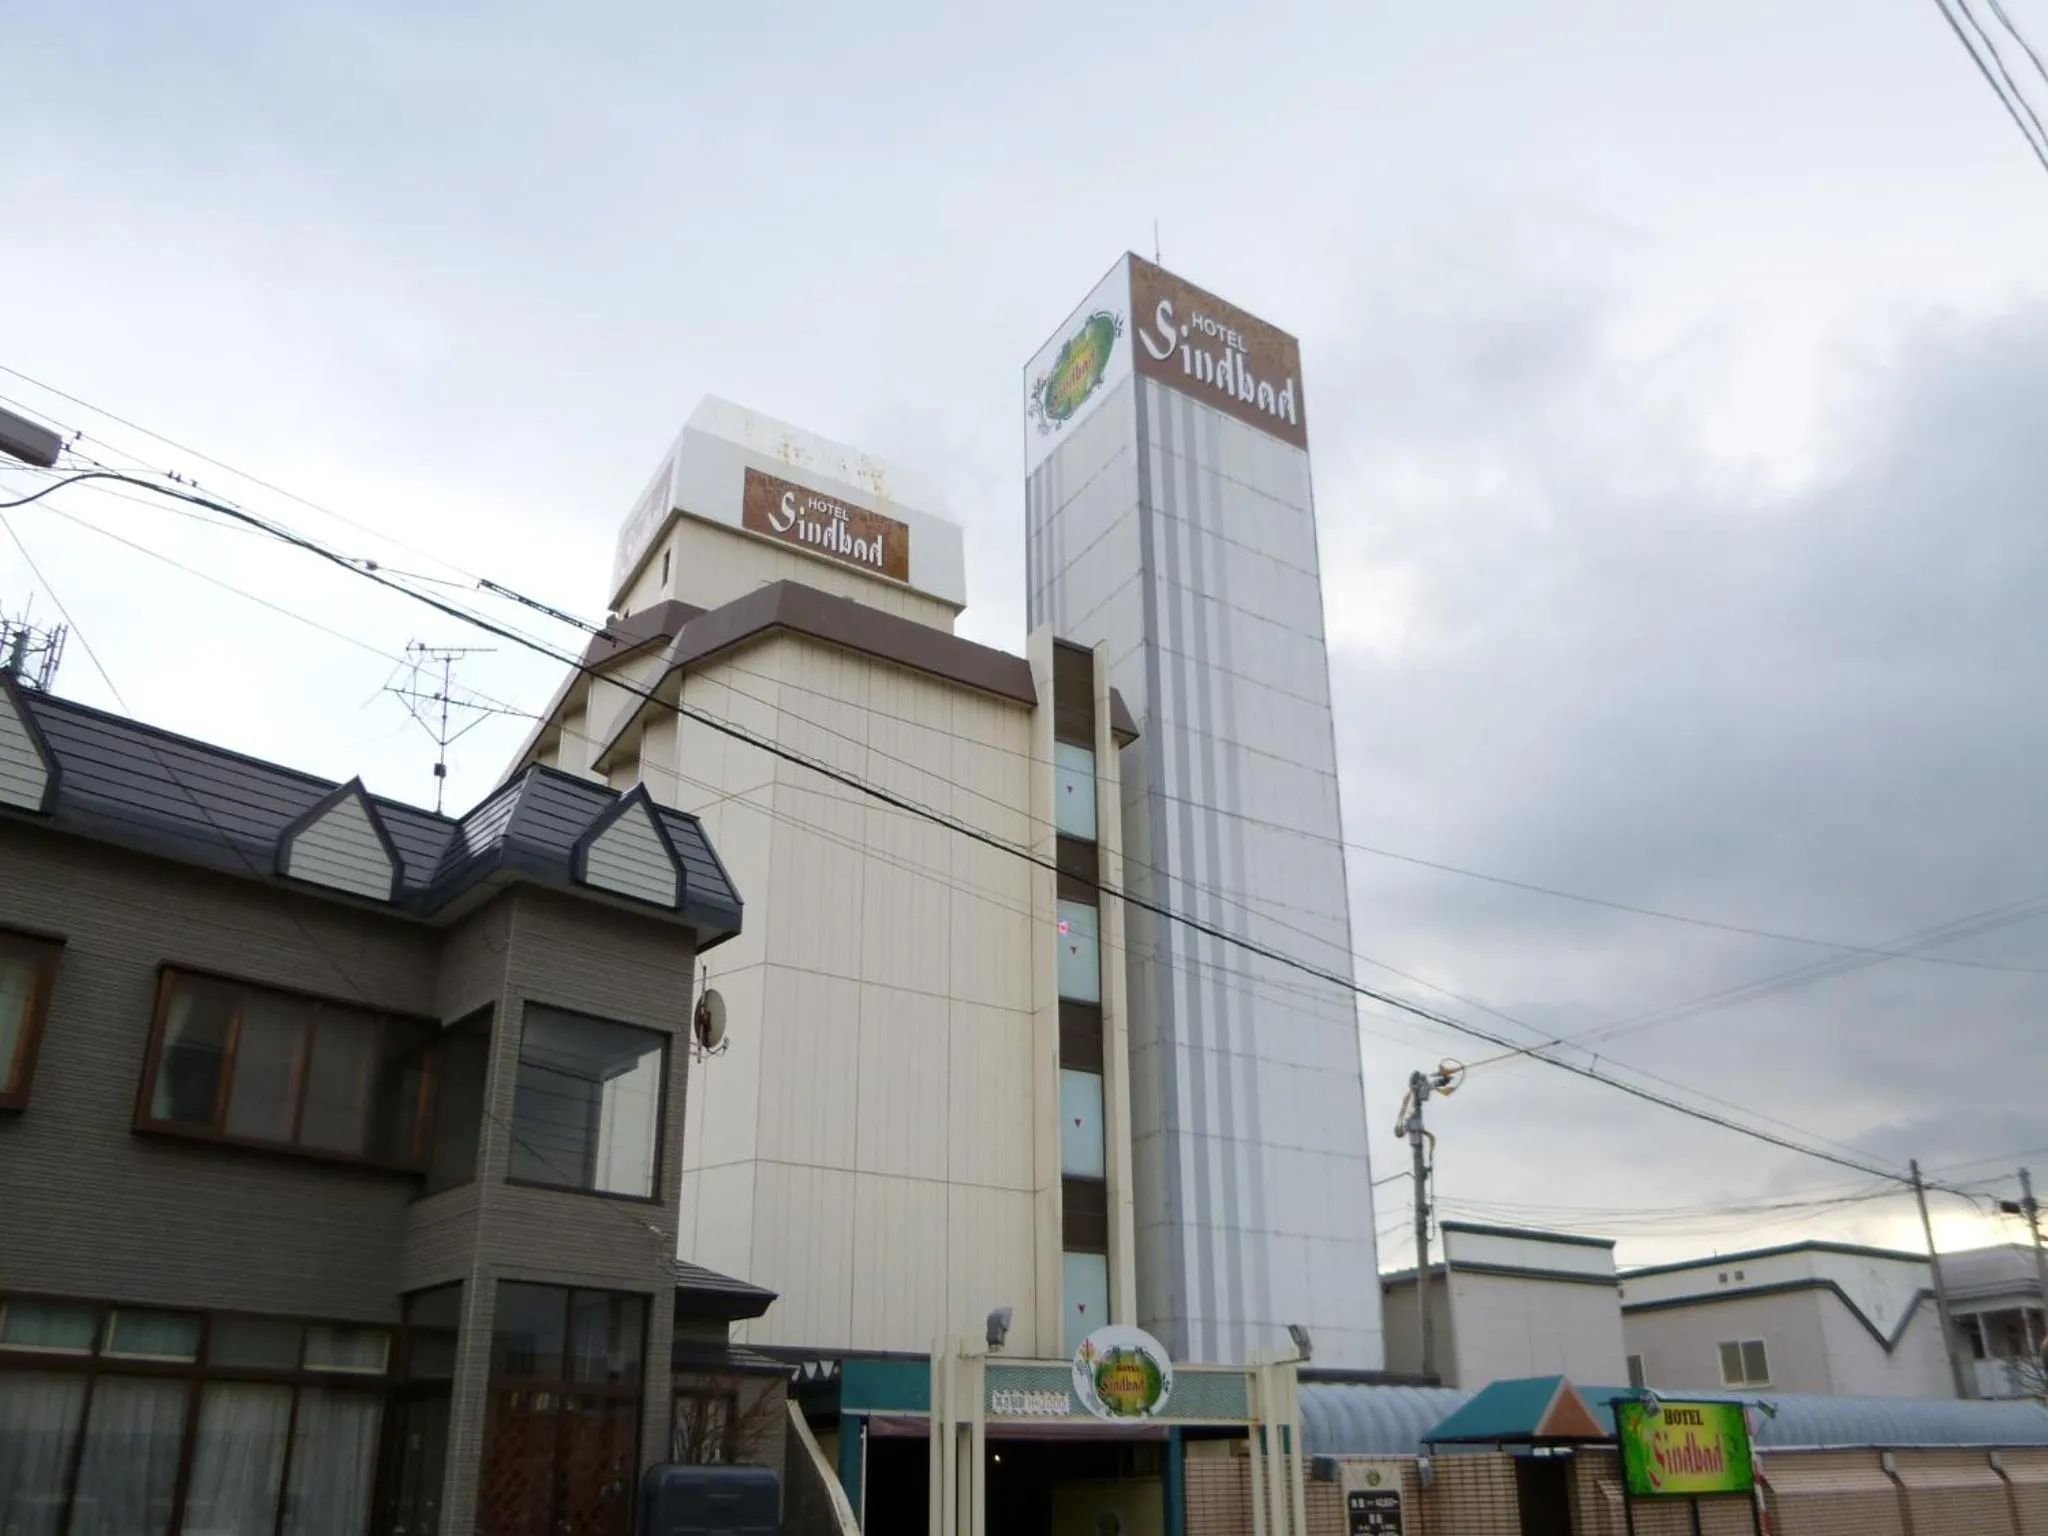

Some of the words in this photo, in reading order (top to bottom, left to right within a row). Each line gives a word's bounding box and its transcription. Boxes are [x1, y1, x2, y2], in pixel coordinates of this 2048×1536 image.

[1191, 311, 1247, 353] HOTEL
[1138, 299, 1297, 426] Sindbad
[767, 491, 884, 568] Sindbad
[807, 497, 850, 521] HOTEL
[1663, 1408, 1704, 1426] HOTEL
[1647, 1430, 1725, 1488] Sindbad
